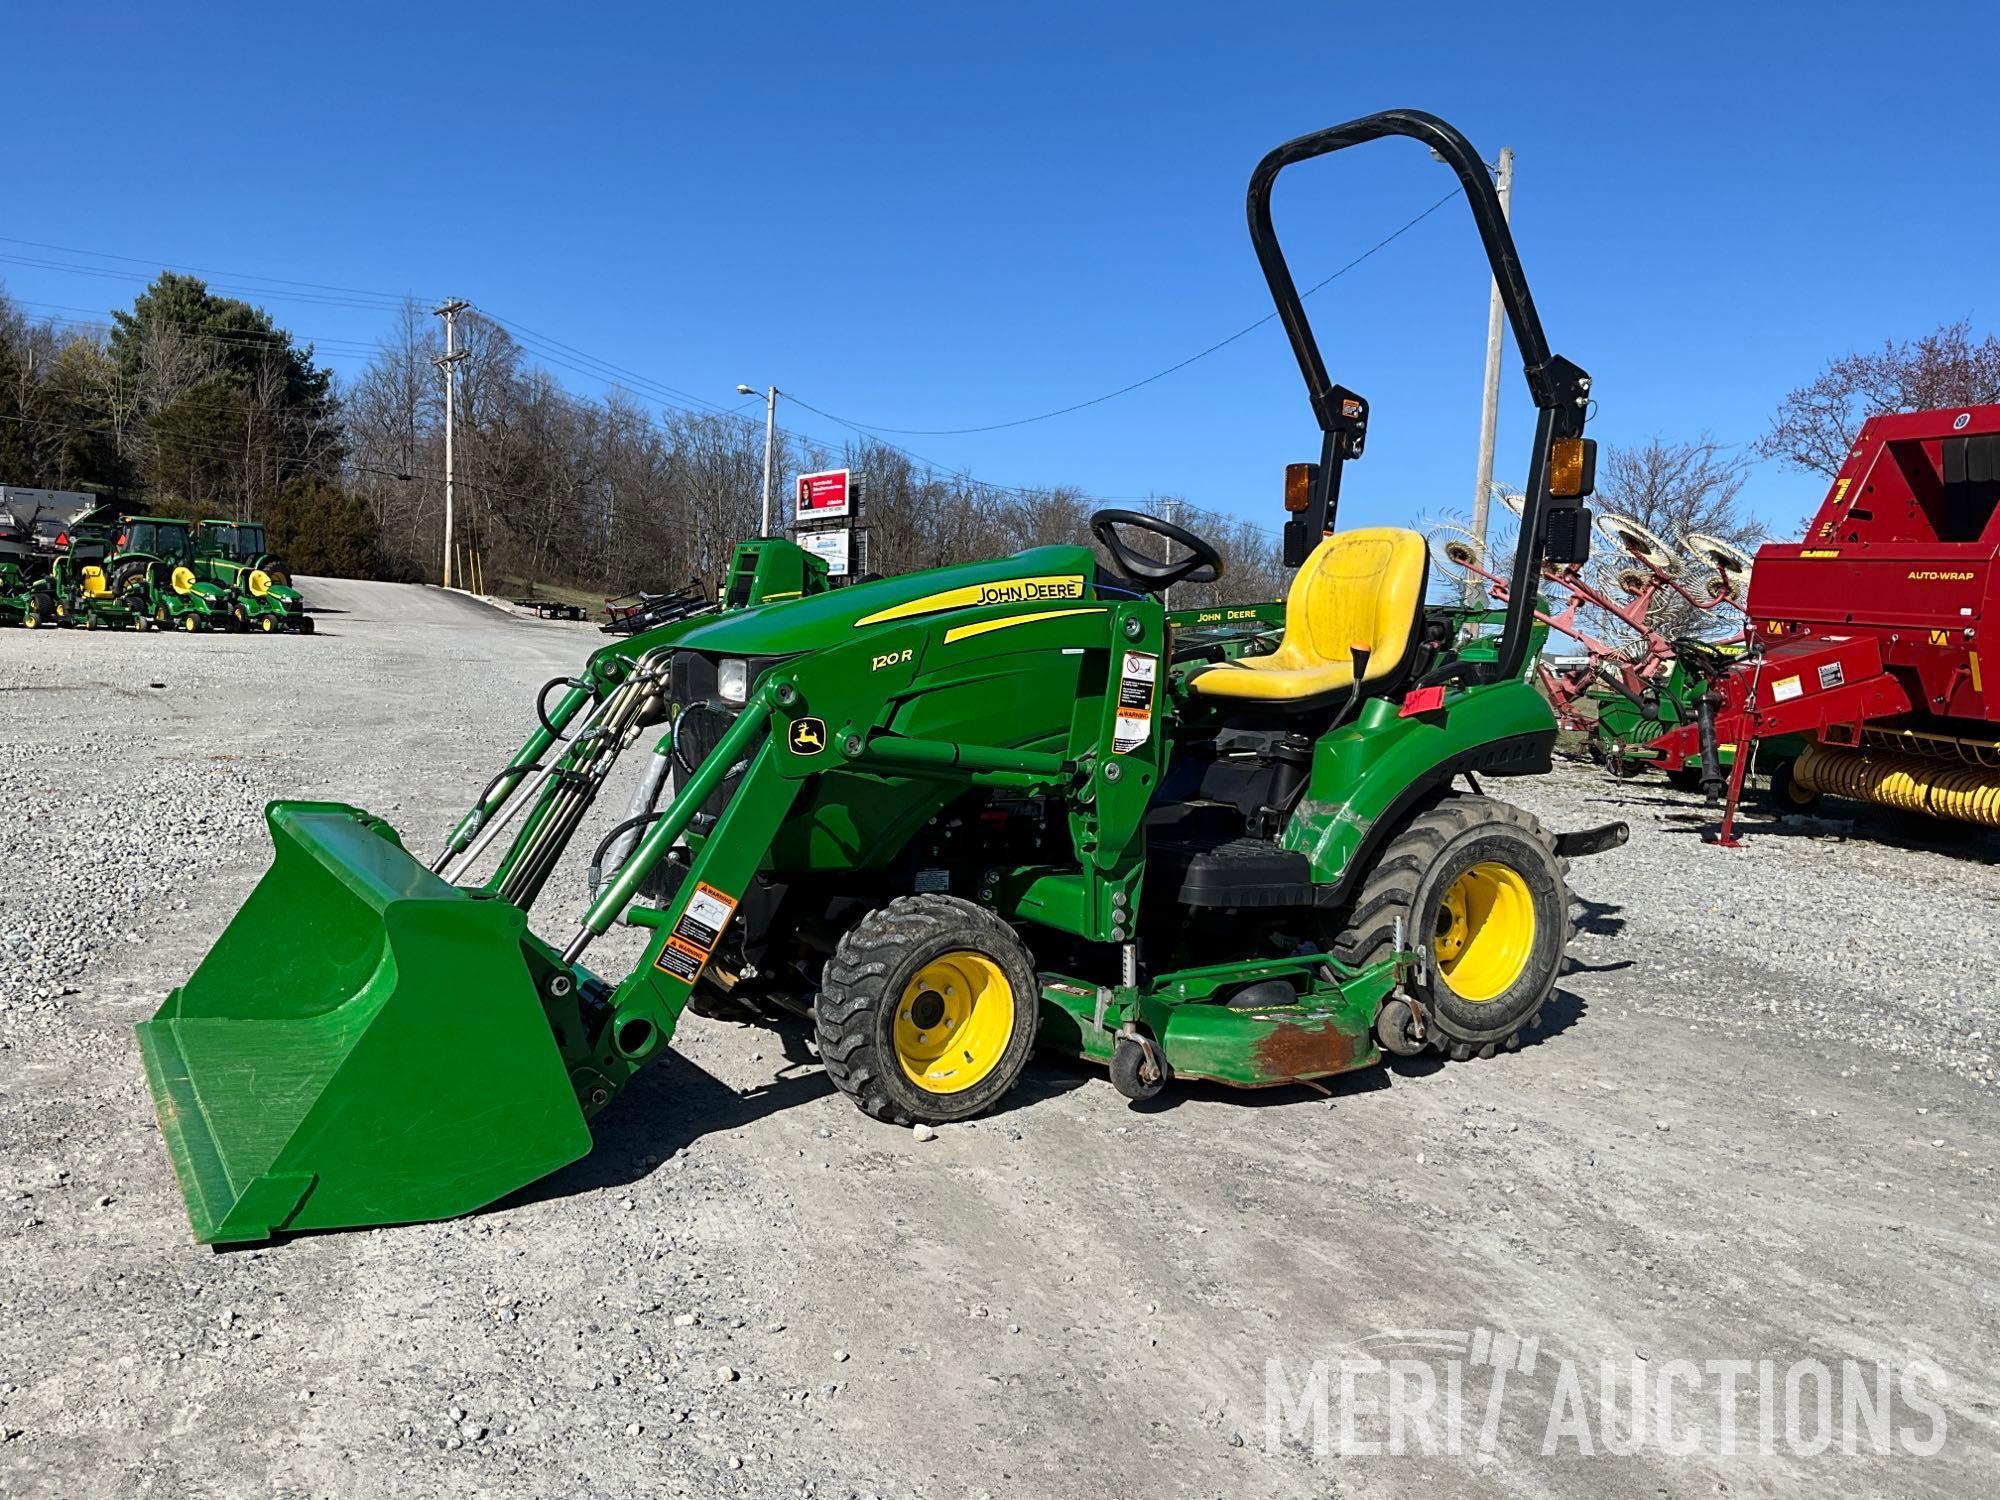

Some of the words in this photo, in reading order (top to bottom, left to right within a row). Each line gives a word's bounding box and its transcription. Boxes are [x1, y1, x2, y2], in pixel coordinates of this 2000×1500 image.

[977, 586, 1022, 604] JOHN
[1025, 583, 1077, 599] DEERE
[1197, 613, 1221, 622] JOHN
[1228, 610, 1256, 620] DEERE
[1123, 710, 1149, 719] WARNING
[707, 889, 732, 905] WARNING
[678, 943, 704, 959] WARNING
